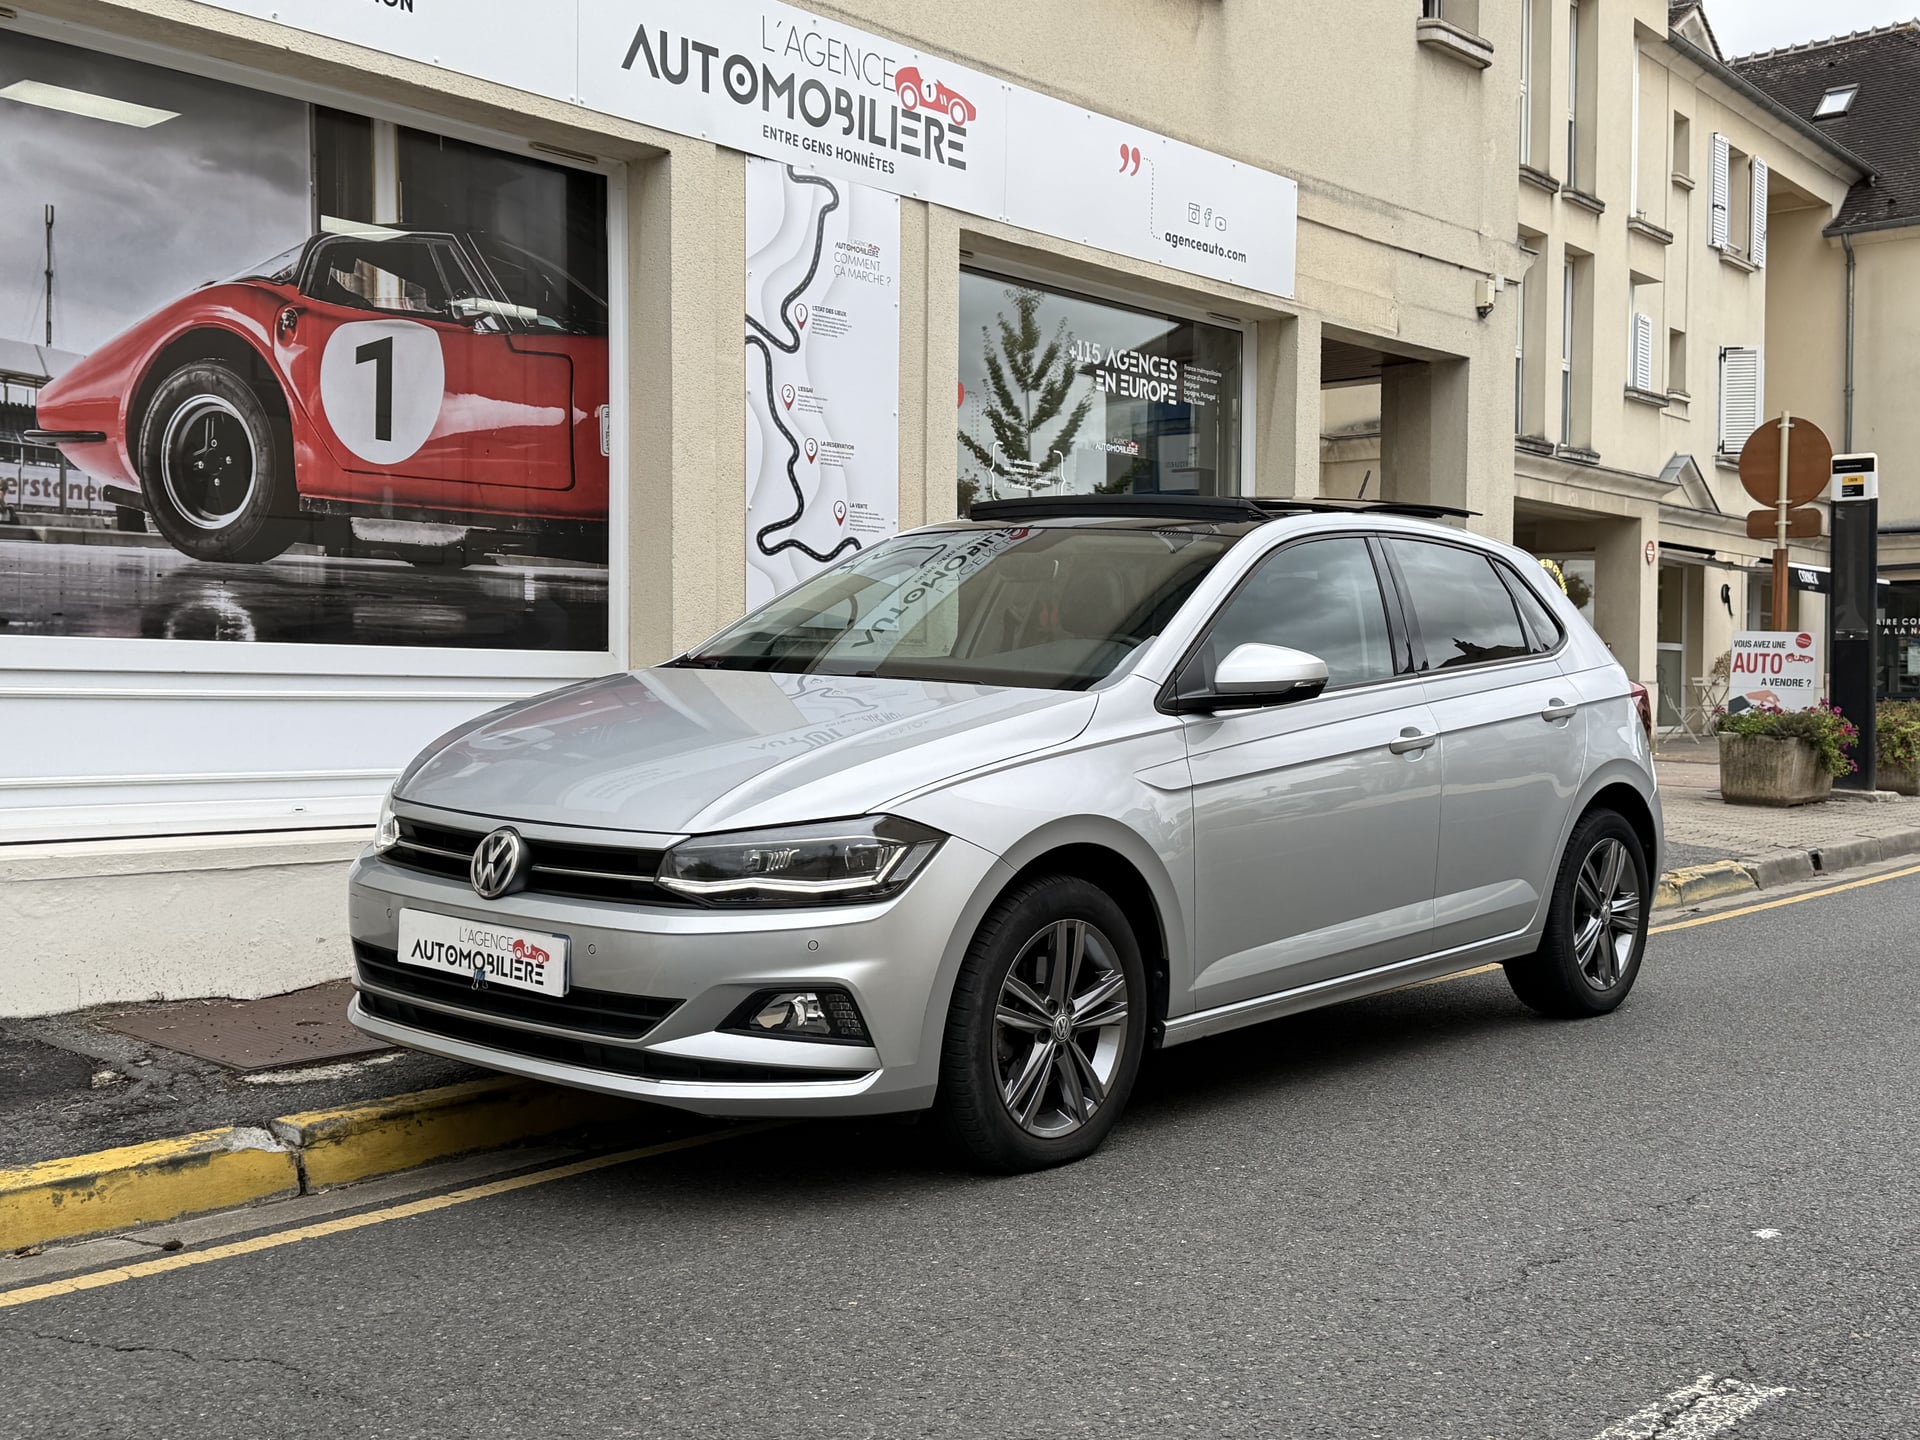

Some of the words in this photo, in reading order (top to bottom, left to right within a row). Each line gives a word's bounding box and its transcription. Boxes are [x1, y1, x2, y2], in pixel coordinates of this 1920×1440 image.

[761, 15, 897, 92] L'AGENCE
[762, 124, 799, 147] ENTRE
[802, 137, 833, 157] GENS
[836, 147, 895, 175] HONNÊTES
[1165, 232, 1247, 263] agenceauto.com
[833, 251, 881, 272] COMMENT
[833, 264, 846, 279] ÇA
[848, 267, 885, 286] MARCHE
[886, 276, 892, 288] ?
[1105, 347, 1177, 381] AGENCES
[355, 335, 395, 442] 1
[785, 388, 792, 399] 2
[1096, 369, 1117, 393] EN
[1120, 374, 1177, 406] EUROPE
[808, 442, 814, 452] 3
[837, 505, 843, 513] 4
[1883, 627, 1890, 635] A
[1894, 627, 1906, 635] LA
[1734, 639, 1752, 648] VOUS
[1753, 640, 1771, 649] AVEZ
[1772, 640, 1787, 649] UNE
[1732, 652, 1783, 674] AUTO
[1760, 677, 1767, 686] A
[1769, 678, 1804, 687] VENDRE
[1806, 679, 1812, 687] ?
[459, 926, 514, 953] L'AGENCE
